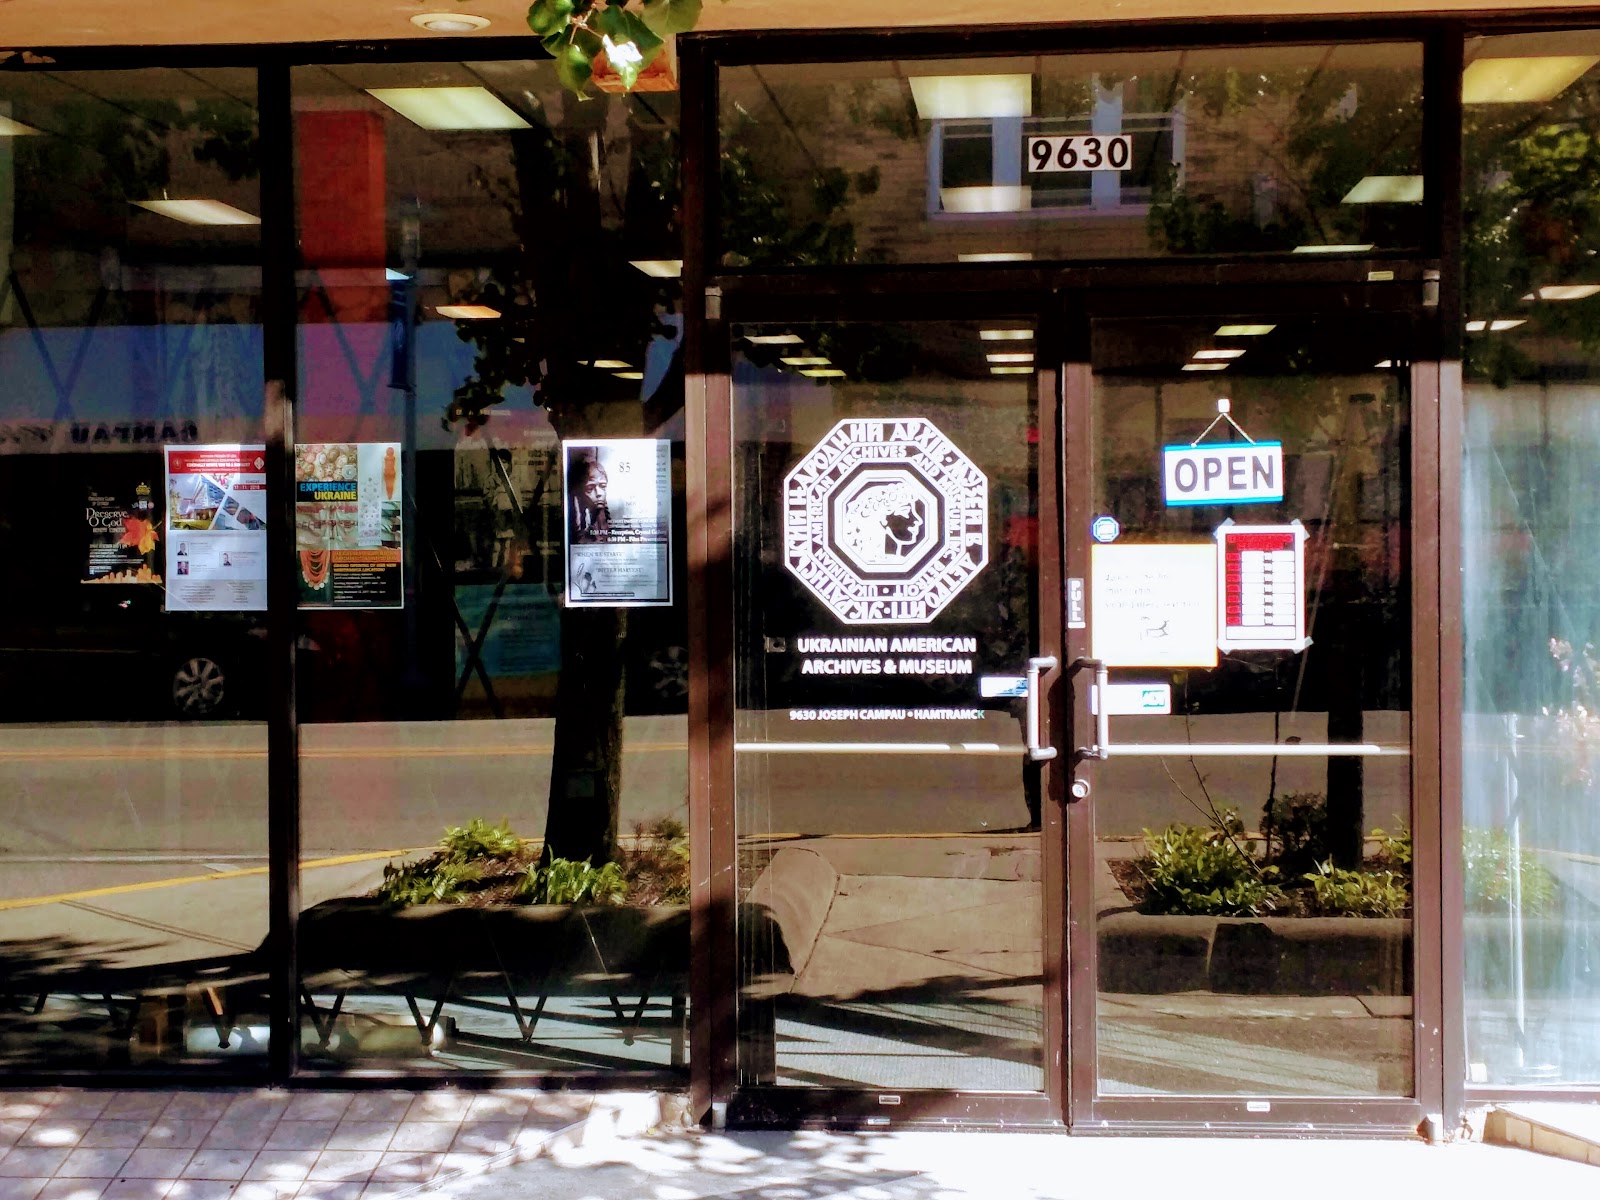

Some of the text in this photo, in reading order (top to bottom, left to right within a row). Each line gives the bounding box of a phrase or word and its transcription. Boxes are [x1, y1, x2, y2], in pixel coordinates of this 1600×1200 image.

[1031, 137, 1129, 170] 9630
[619, 462, 631, 473] 85
[835, 445, 907, 475] ARCHIVES
[912, 452, 941, 477] AND
[1174, 454, 1274, 492] OPEN
[299, 483, 356, 492] EXPERIENCE
[313, 491, 357, 500] UKRAINE
[811, 475, 835, 544] AMERICAN
[88, 517, 123, 528] O God
[813, 547, 878, 597] UKRAINIAN
[895, 558, 948, 596] DETROIT
[1070, 580, 1082, 622] PULL
[797, 638, 977, 653] UKRAINIAN AMERICAN
[801, 660, 973, 674] ARCHIVES & MUSEUM
[789, 710, 985, 721] 9630 JOSEPH CAMPAU HAMTRAMCK
